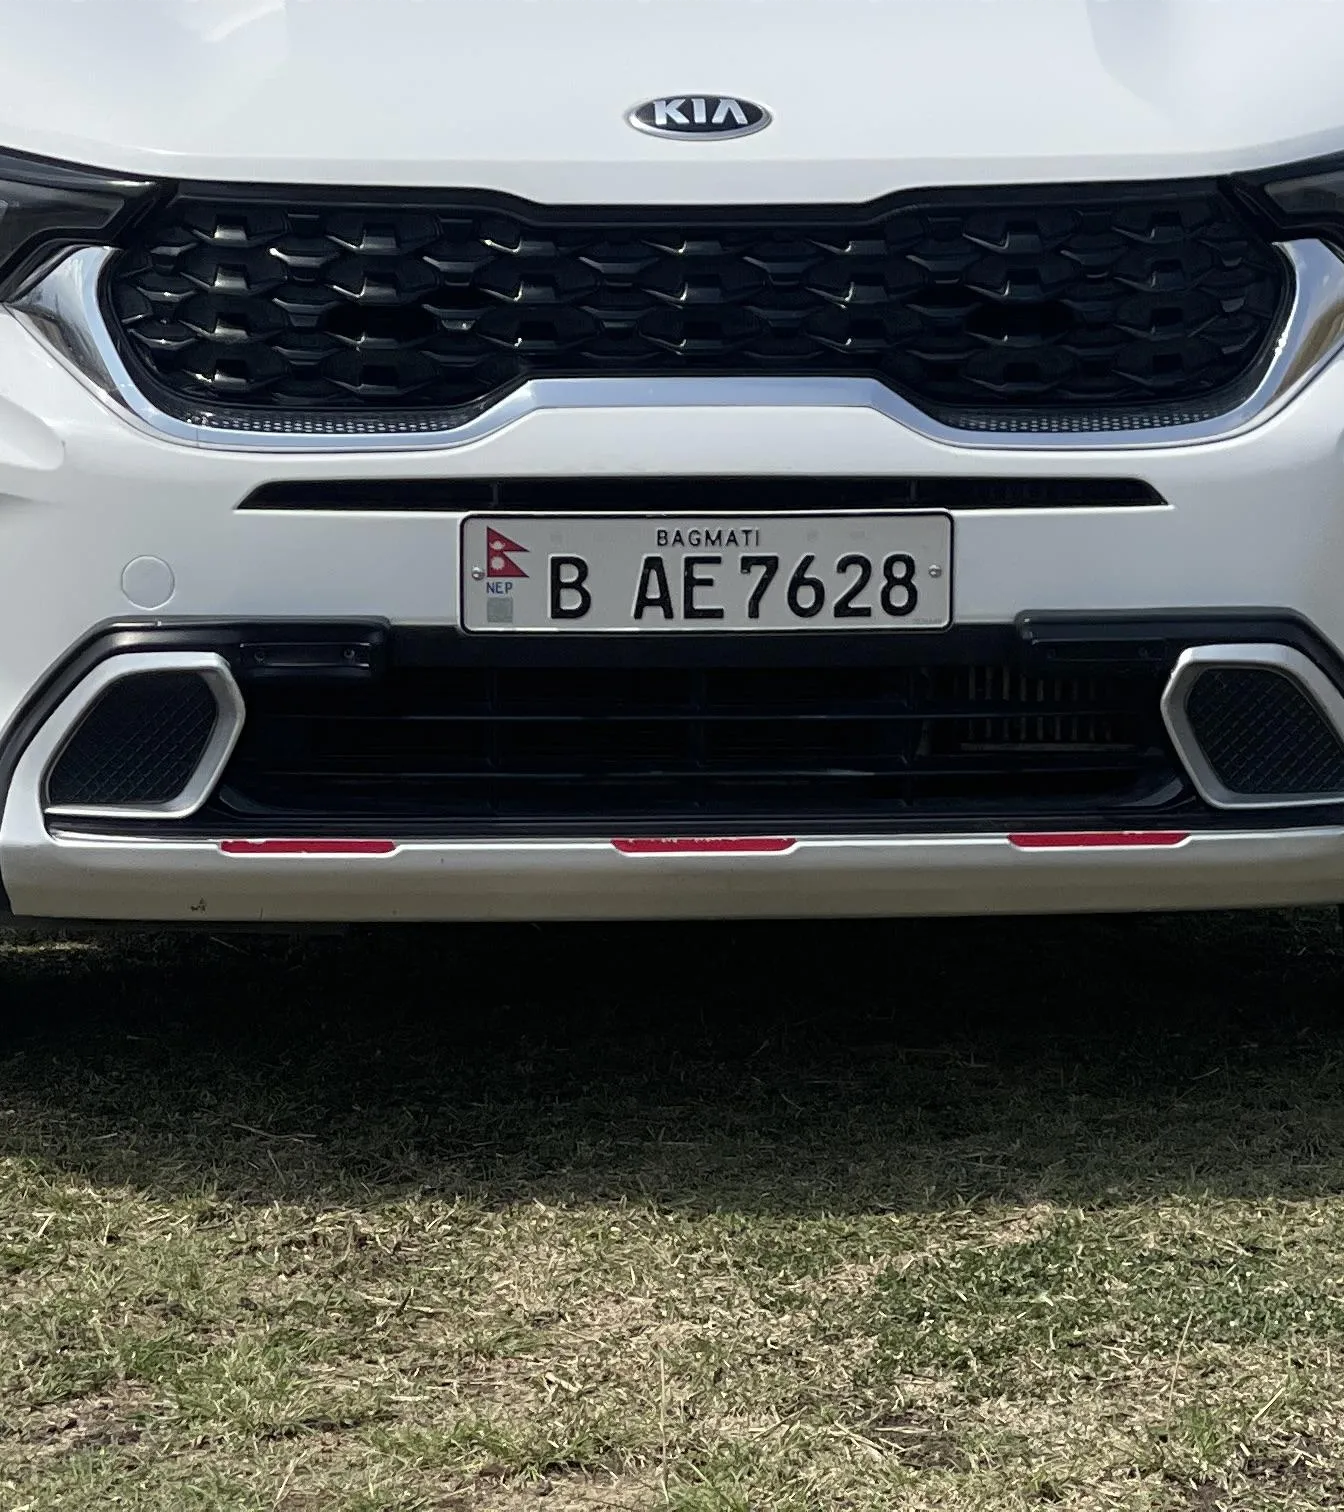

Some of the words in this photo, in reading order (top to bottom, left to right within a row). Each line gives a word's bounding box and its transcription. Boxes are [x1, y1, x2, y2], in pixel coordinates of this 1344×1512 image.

[653, 98, 748, 125] KIA
[657, 529, 760, 547] BAGMATI
[486, 581, 513, 594] NEP
[549, 555, 592, 620] B
